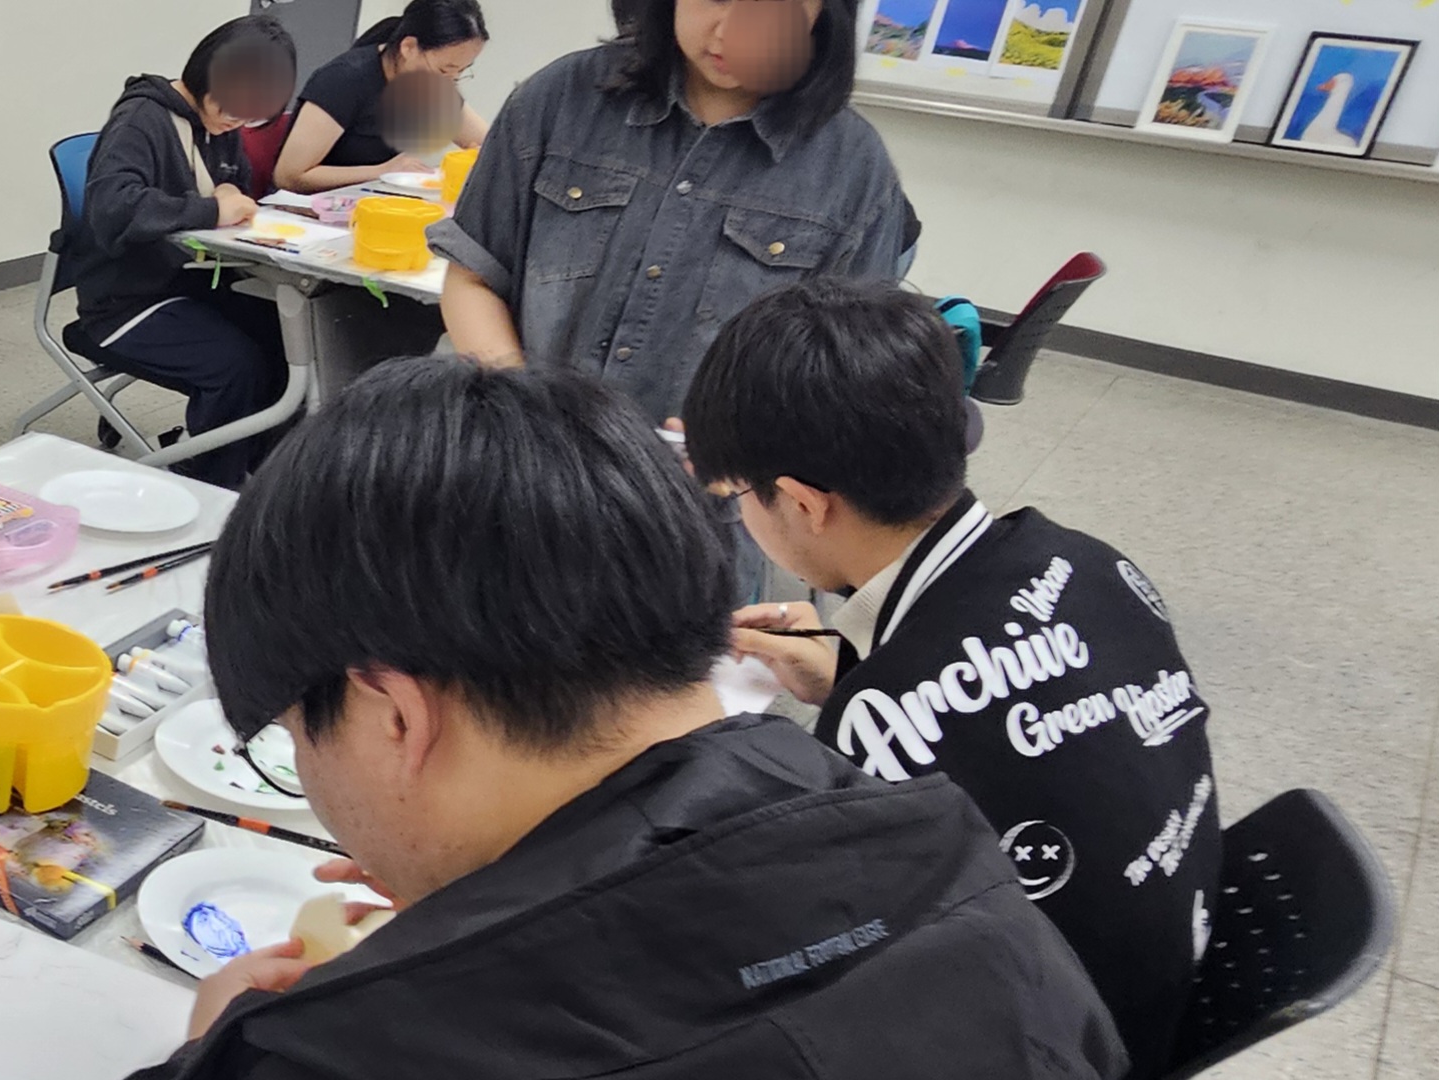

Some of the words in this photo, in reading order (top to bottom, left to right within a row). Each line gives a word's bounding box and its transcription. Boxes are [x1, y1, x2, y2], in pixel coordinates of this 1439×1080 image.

[1010, 556, 1073, 622] Urban
[837, 621, 1089, 782] Archive
[1006, 692, 1117, 757] Green
